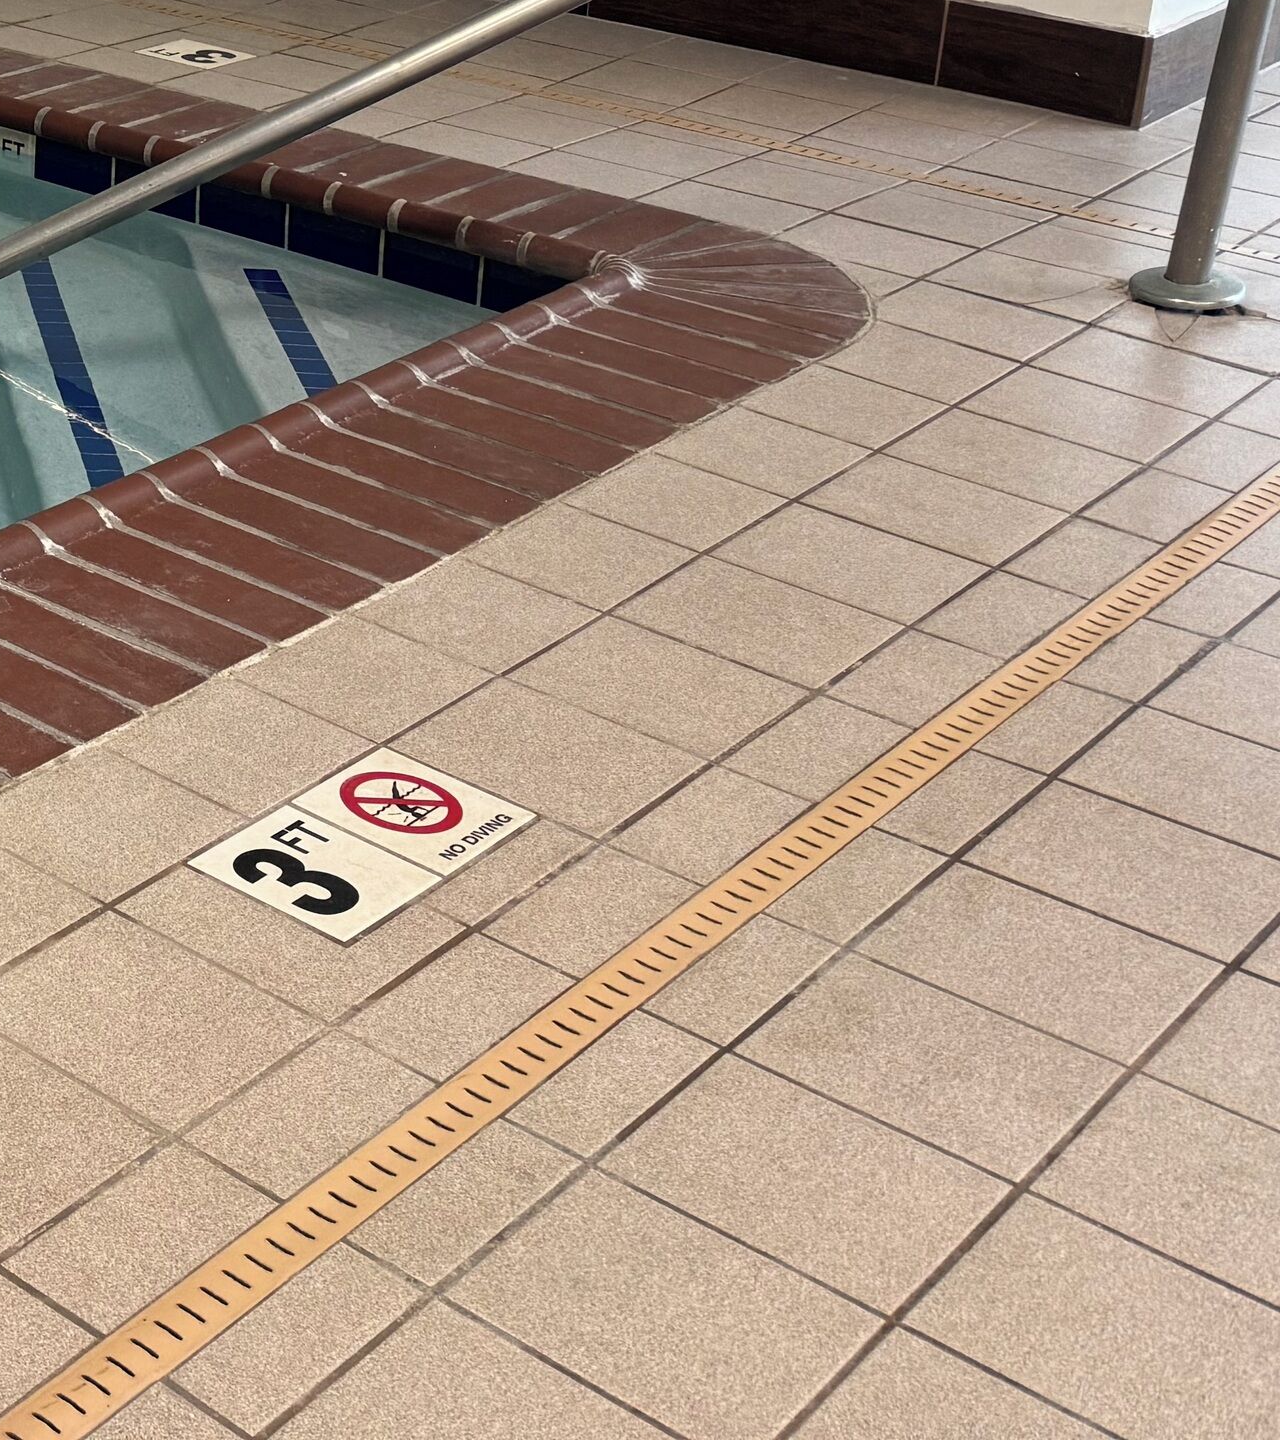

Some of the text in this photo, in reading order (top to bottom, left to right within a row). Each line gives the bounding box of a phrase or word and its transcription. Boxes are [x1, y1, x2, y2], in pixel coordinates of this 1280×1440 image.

[150, 47, 237, 64] 3 FT
[438, 812, 514, 861] NO DIVING
[232, 819, 360, 916] 3 FT
